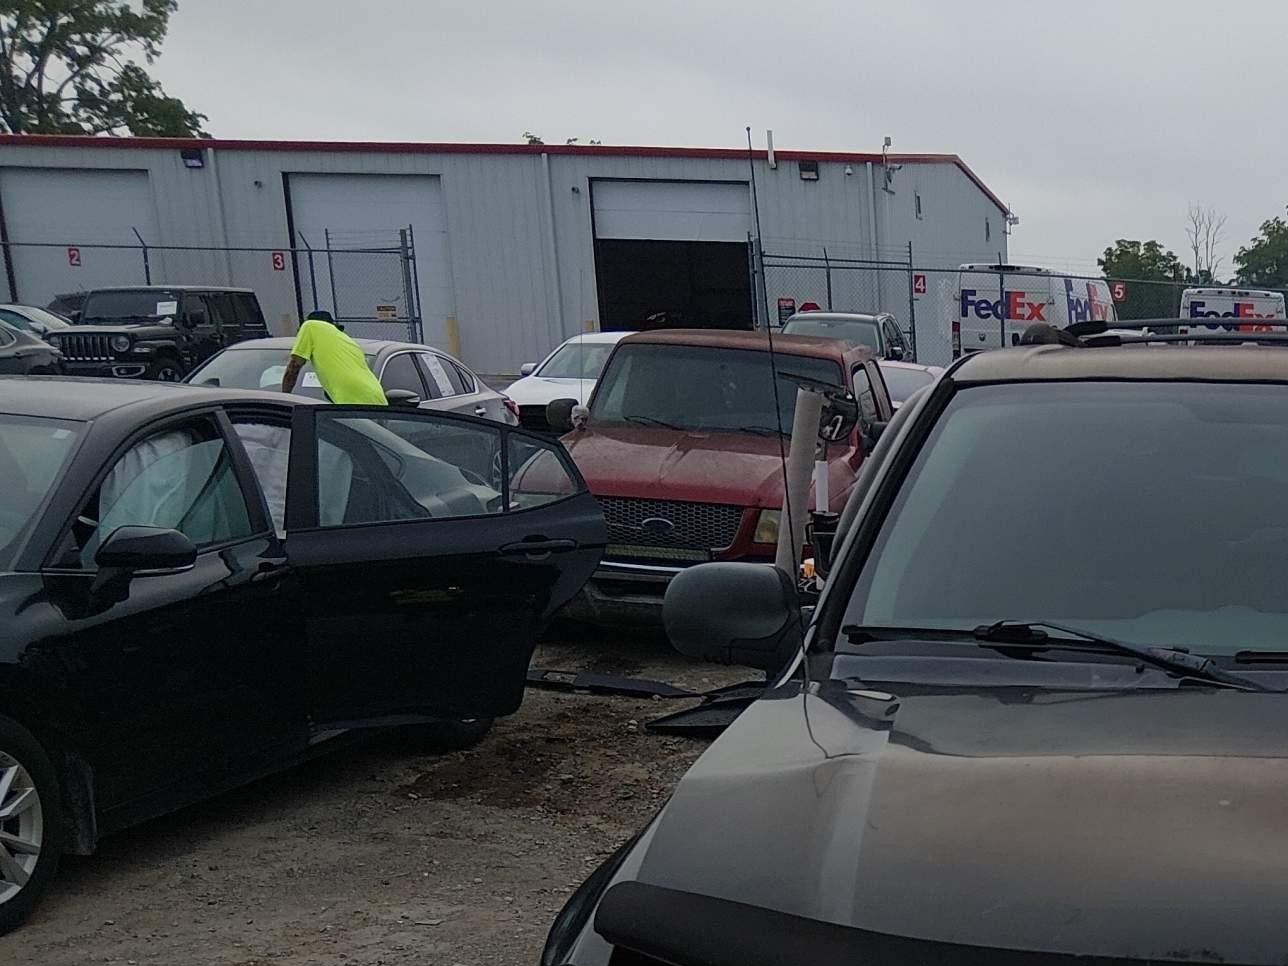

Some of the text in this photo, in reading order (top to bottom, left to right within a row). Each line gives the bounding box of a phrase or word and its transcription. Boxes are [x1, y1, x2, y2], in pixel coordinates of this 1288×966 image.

[70, 249, 80, 265] 2
[274, 254, 284, 269] 3
[915, 276, 925, 293] 4
[1114, 284, 1124, 299] 5
[961, 289, 1046, 321] FedEx
